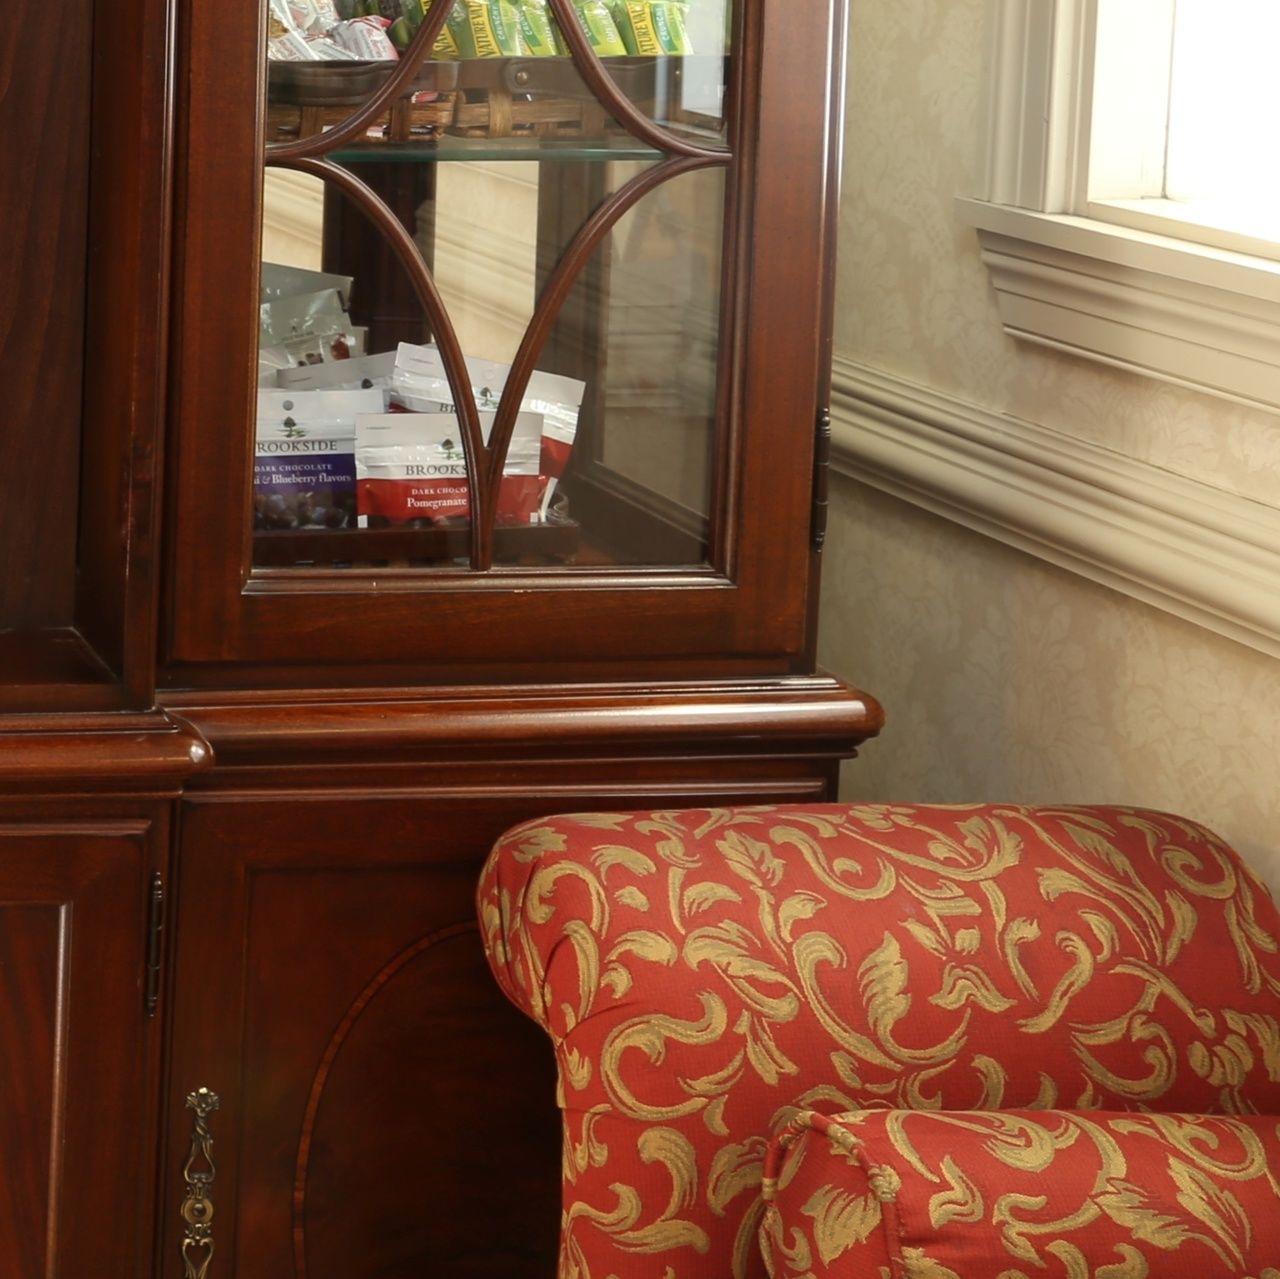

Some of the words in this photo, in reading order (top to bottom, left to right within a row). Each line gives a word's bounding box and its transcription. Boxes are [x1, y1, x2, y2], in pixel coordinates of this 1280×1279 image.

[257, 439, 338, 453] ROOKSIDE
[278, 463, 333, 472] CHOCOLATE
[406, 463, 468, 476] BROOKS
[272, 472, 317, 486] Blueberry
[319, 471, 352, 483] flavors
[411, 487, 435, 496] DARK
[436, 486, 467, 495] CHOCO
[406, 497, 467, 510] Pomegranate
